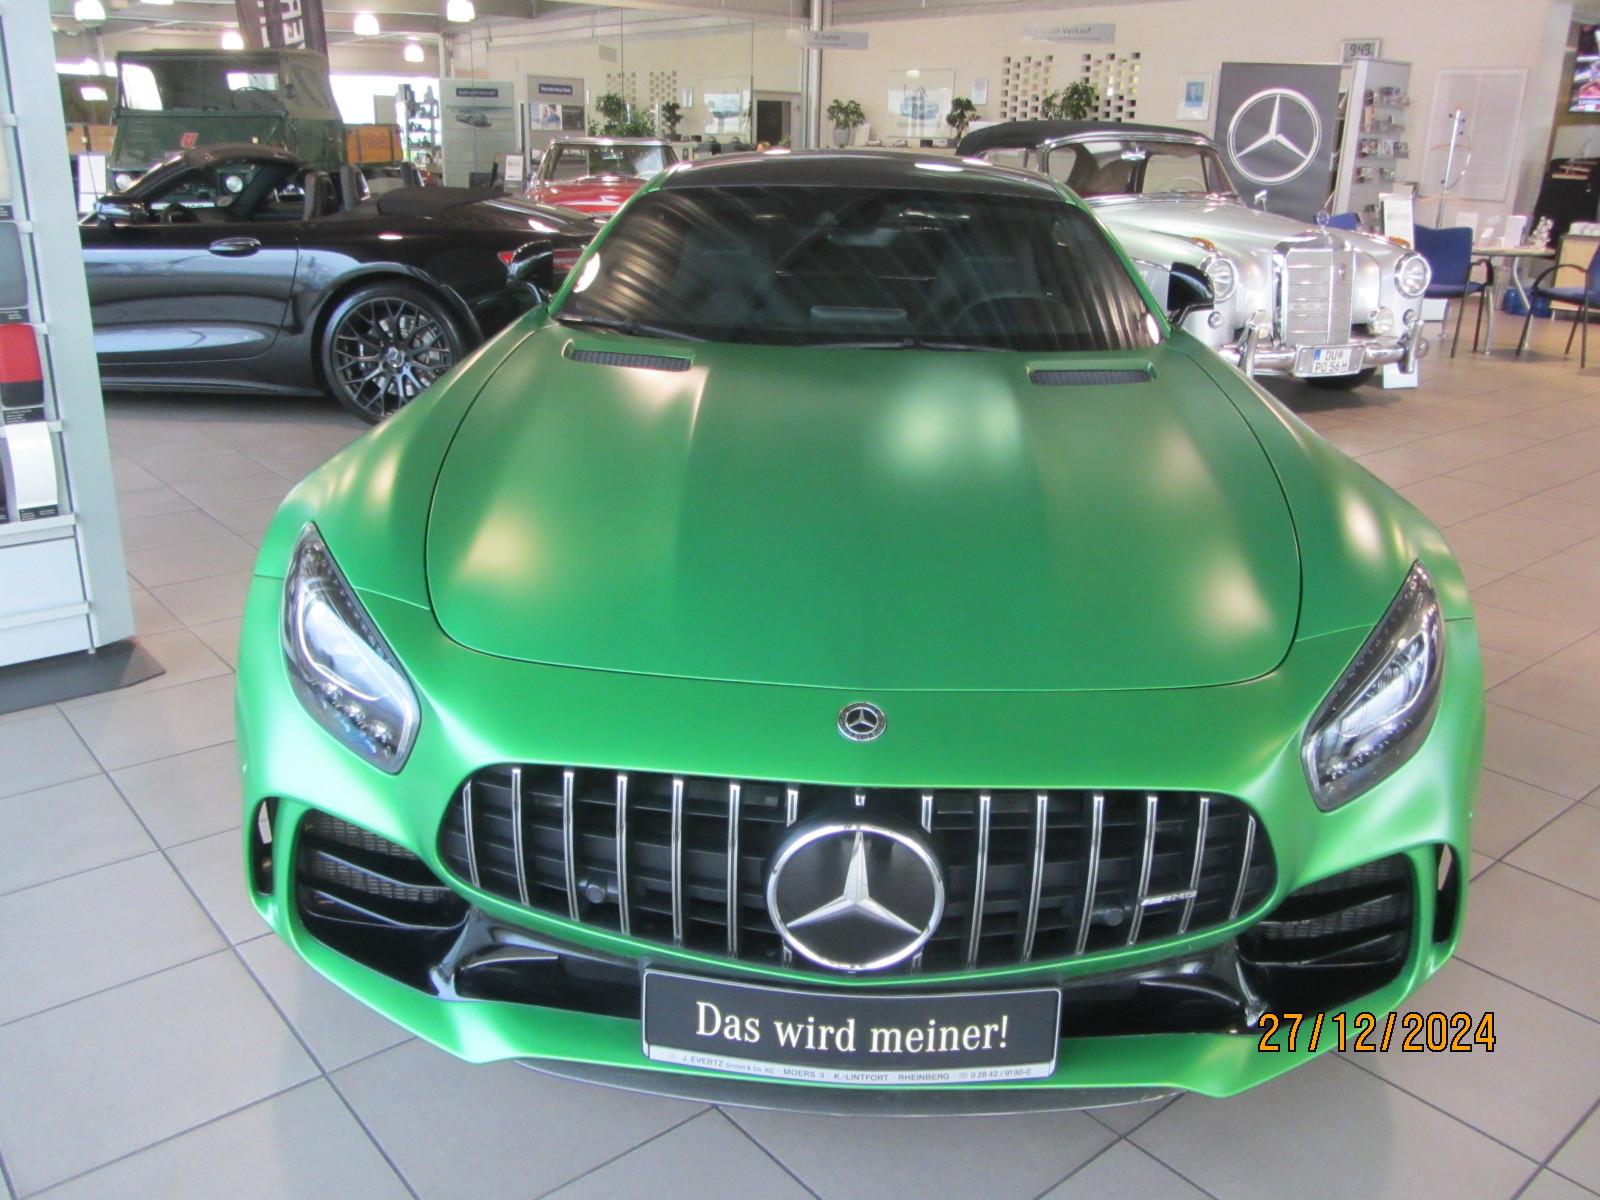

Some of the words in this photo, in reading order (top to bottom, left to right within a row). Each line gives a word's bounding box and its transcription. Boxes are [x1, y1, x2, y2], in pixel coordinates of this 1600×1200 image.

[695, 1001, 760, 1043] Das
[773, 1016, 857, 1052] wird
[868, 1014, 1008, 1054] meiner!
[690, 1056, 725, 1067] EVERTZ
[783, 1068, 816, 1078] MOERS
[898, 1072, 950, 1082] RHEINBERG
